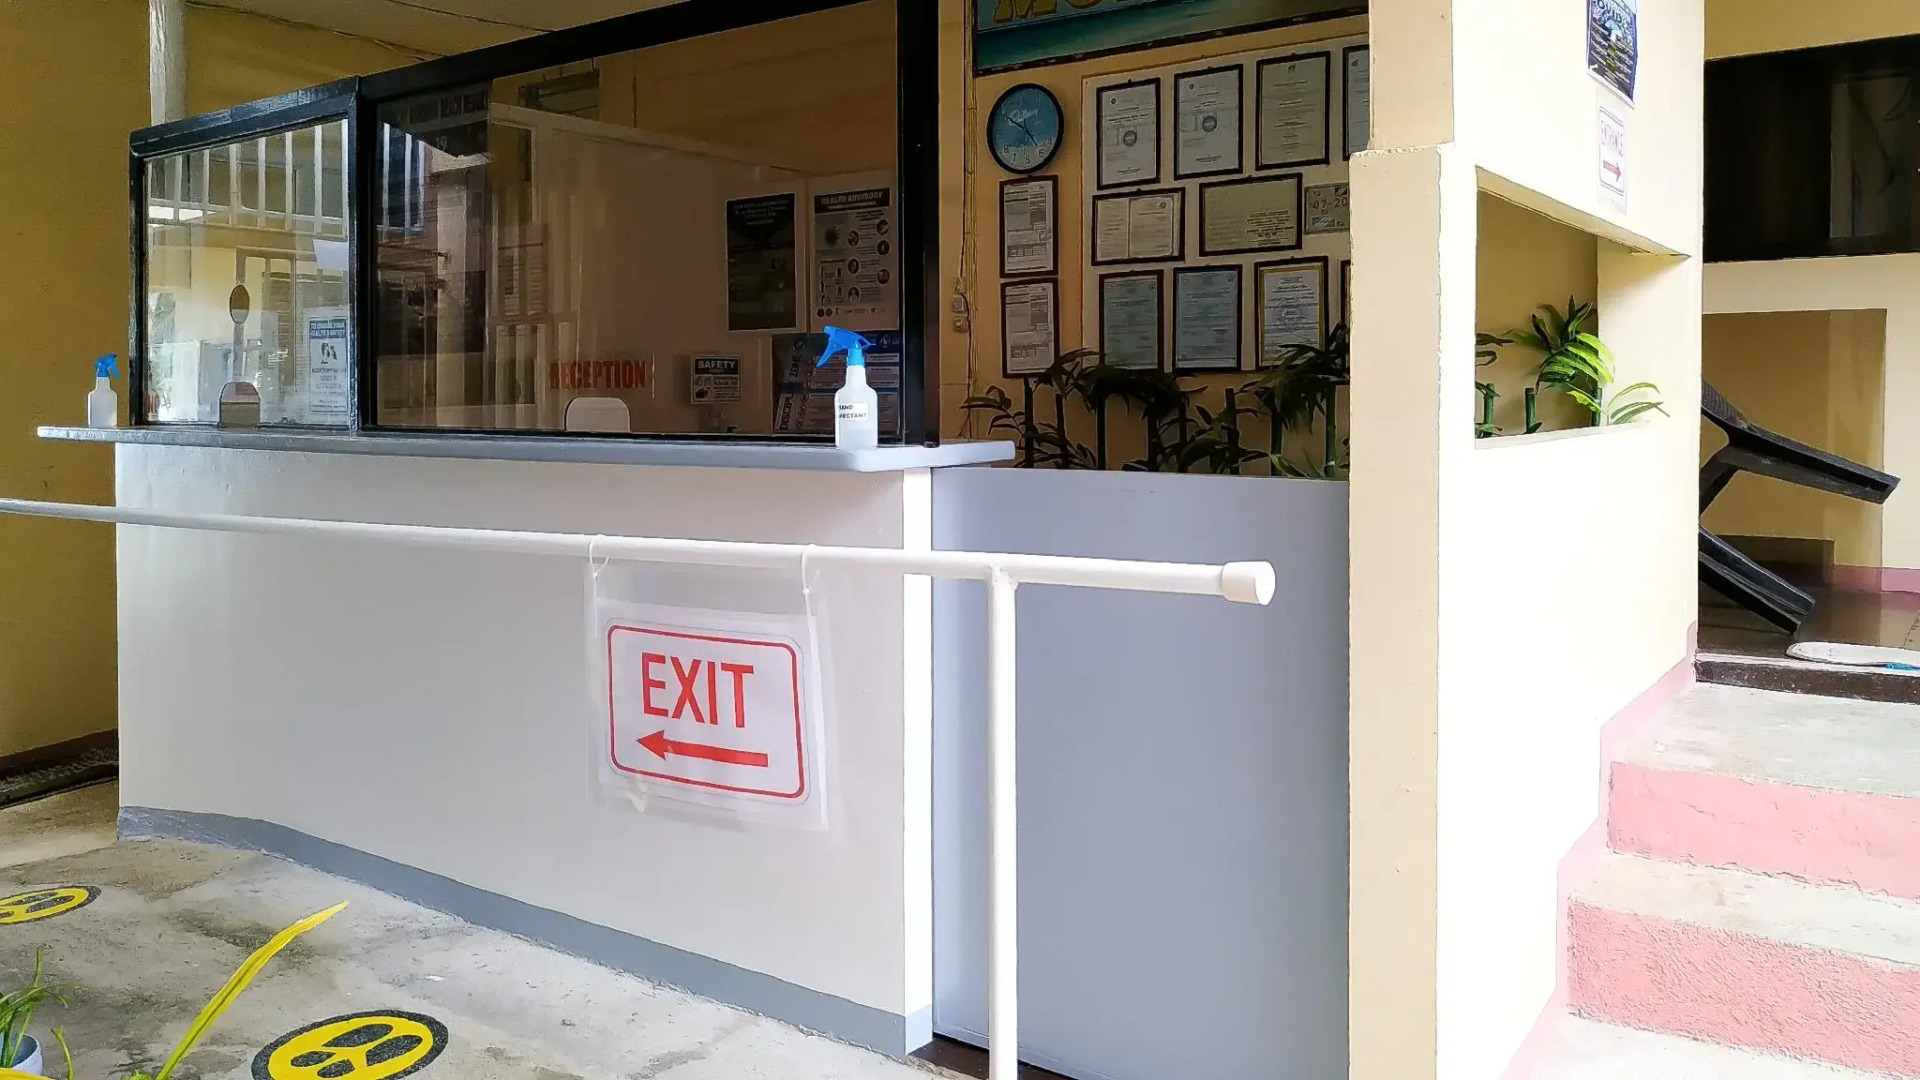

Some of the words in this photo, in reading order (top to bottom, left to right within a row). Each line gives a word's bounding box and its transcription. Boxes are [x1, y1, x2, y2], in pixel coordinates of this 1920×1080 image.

[820, 195, 846, 206] HEALTH
[847, 191, 884, 203] ADVISORY
[549, 360, 647, 389] RECEPTION
[697, 360, 736, 369] SAFETY
[642, 652, 754, 728] EXIT
